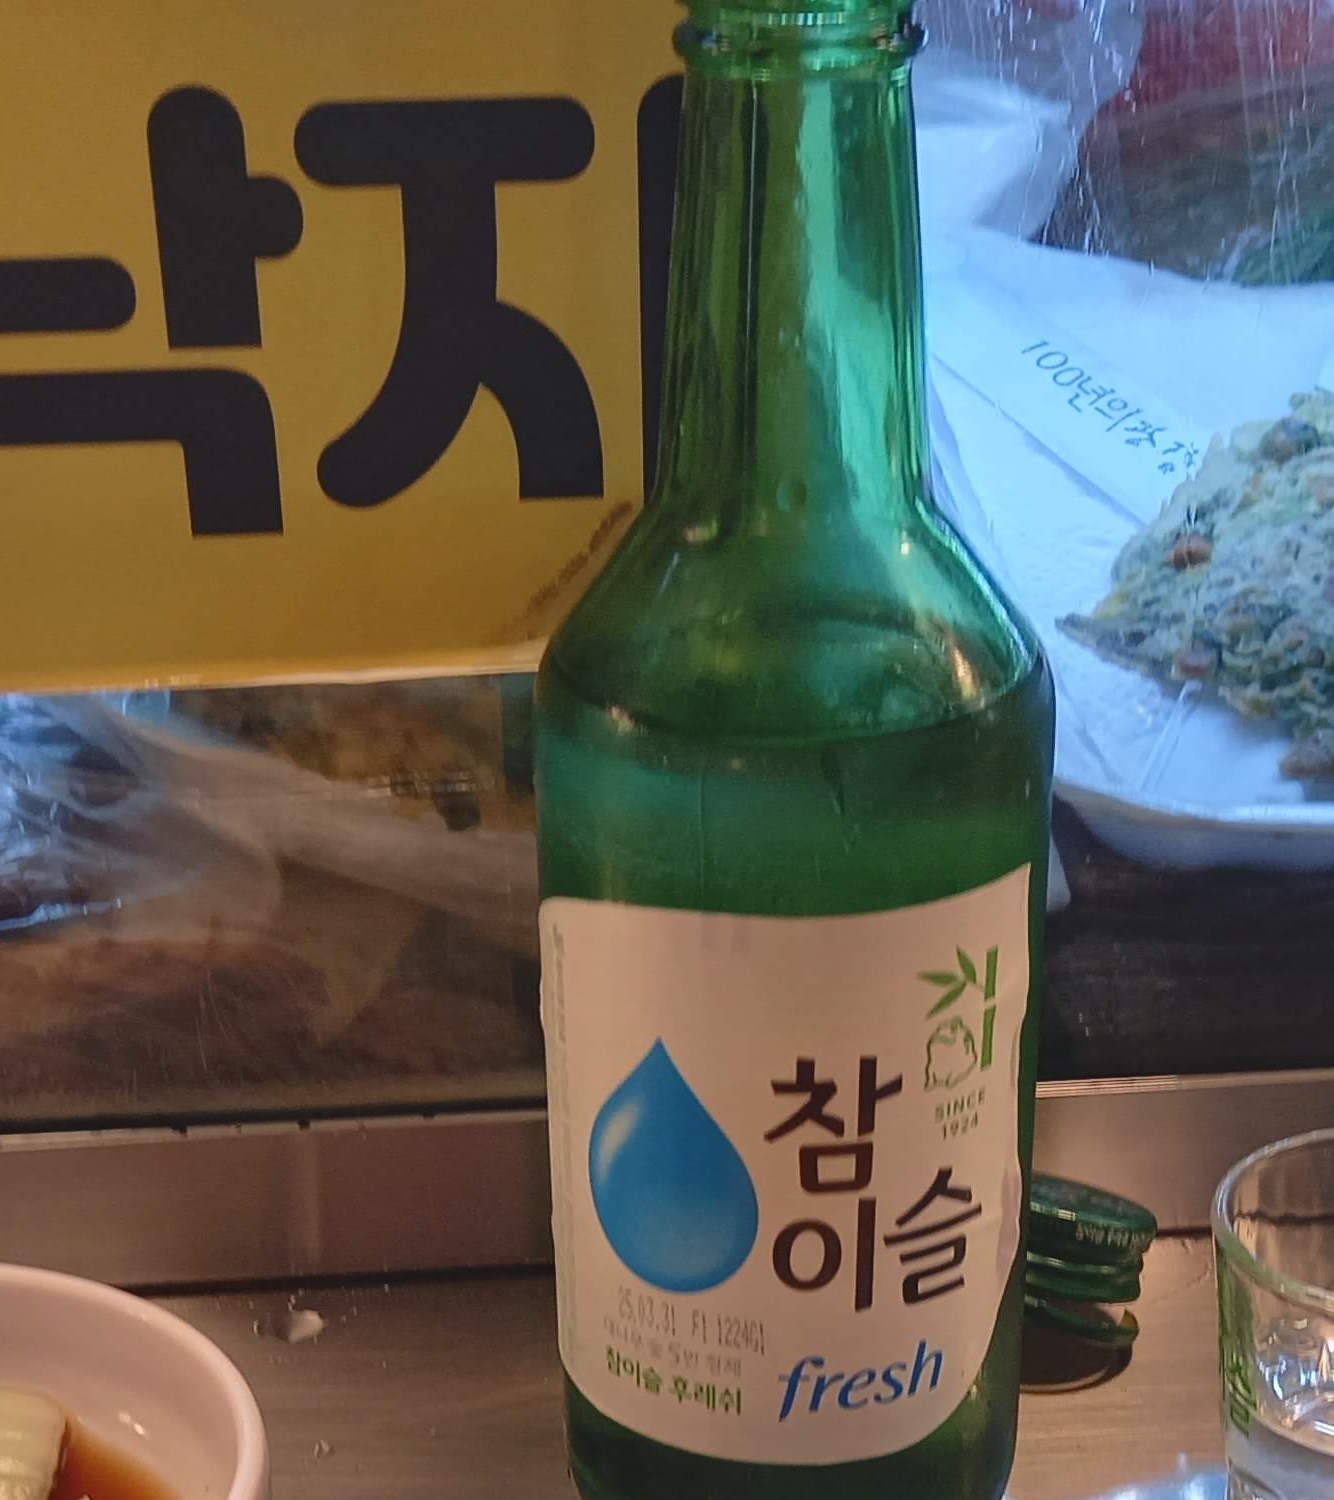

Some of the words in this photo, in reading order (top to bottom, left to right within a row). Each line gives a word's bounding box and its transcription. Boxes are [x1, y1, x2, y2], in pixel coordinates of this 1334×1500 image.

[934, 1086, 987, 1123] SINCE
[940, 1114, 980, 1142] 1924
[669, 1373, 743, 1417] 후레쉬
[777, 1337, 945, 1423] fresh
